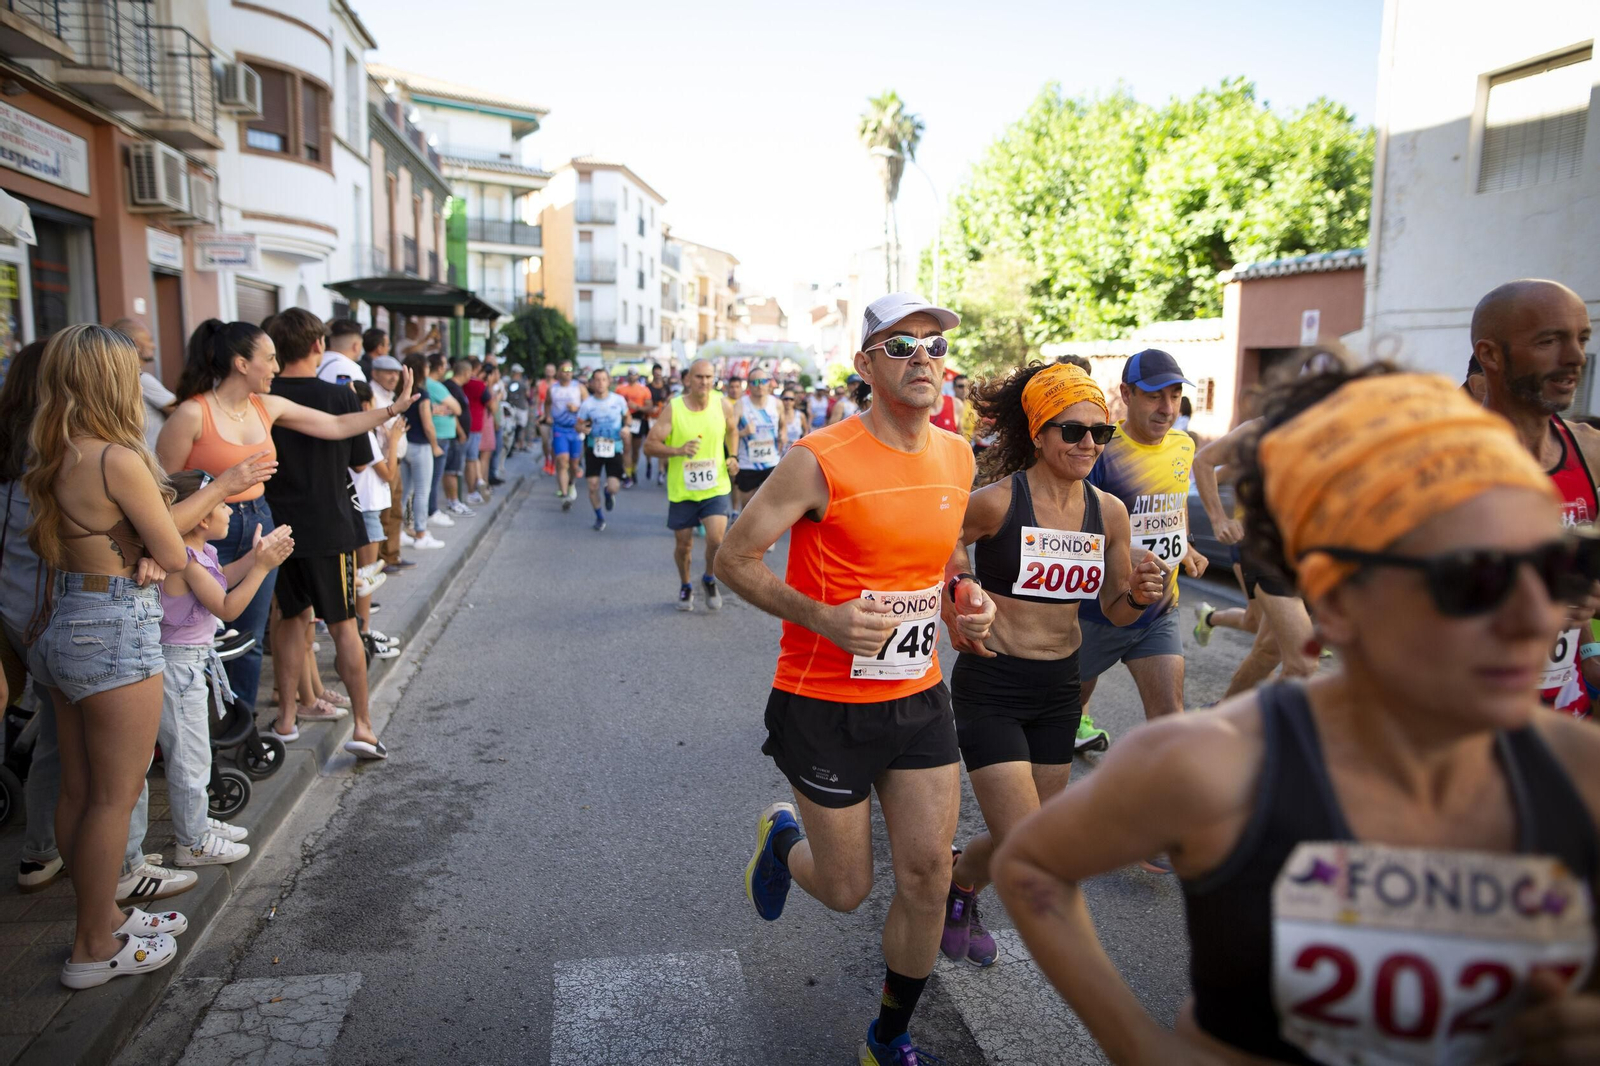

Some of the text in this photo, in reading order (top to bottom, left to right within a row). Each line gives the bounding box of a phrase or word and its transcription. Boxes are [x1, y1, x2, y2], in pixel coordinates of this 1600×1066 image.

[690, 470, 714, 483] 316
[1146, 515, 1179, 530] FONDO
[1042, 538, 1092, 554] FONDO
[1142, 534, 1182, 561] 736
[1021, 561, 1102, 594] 2008
[884, 595, 937, 615] ONDO
[1346, 859, 1547, 918] FONDO
